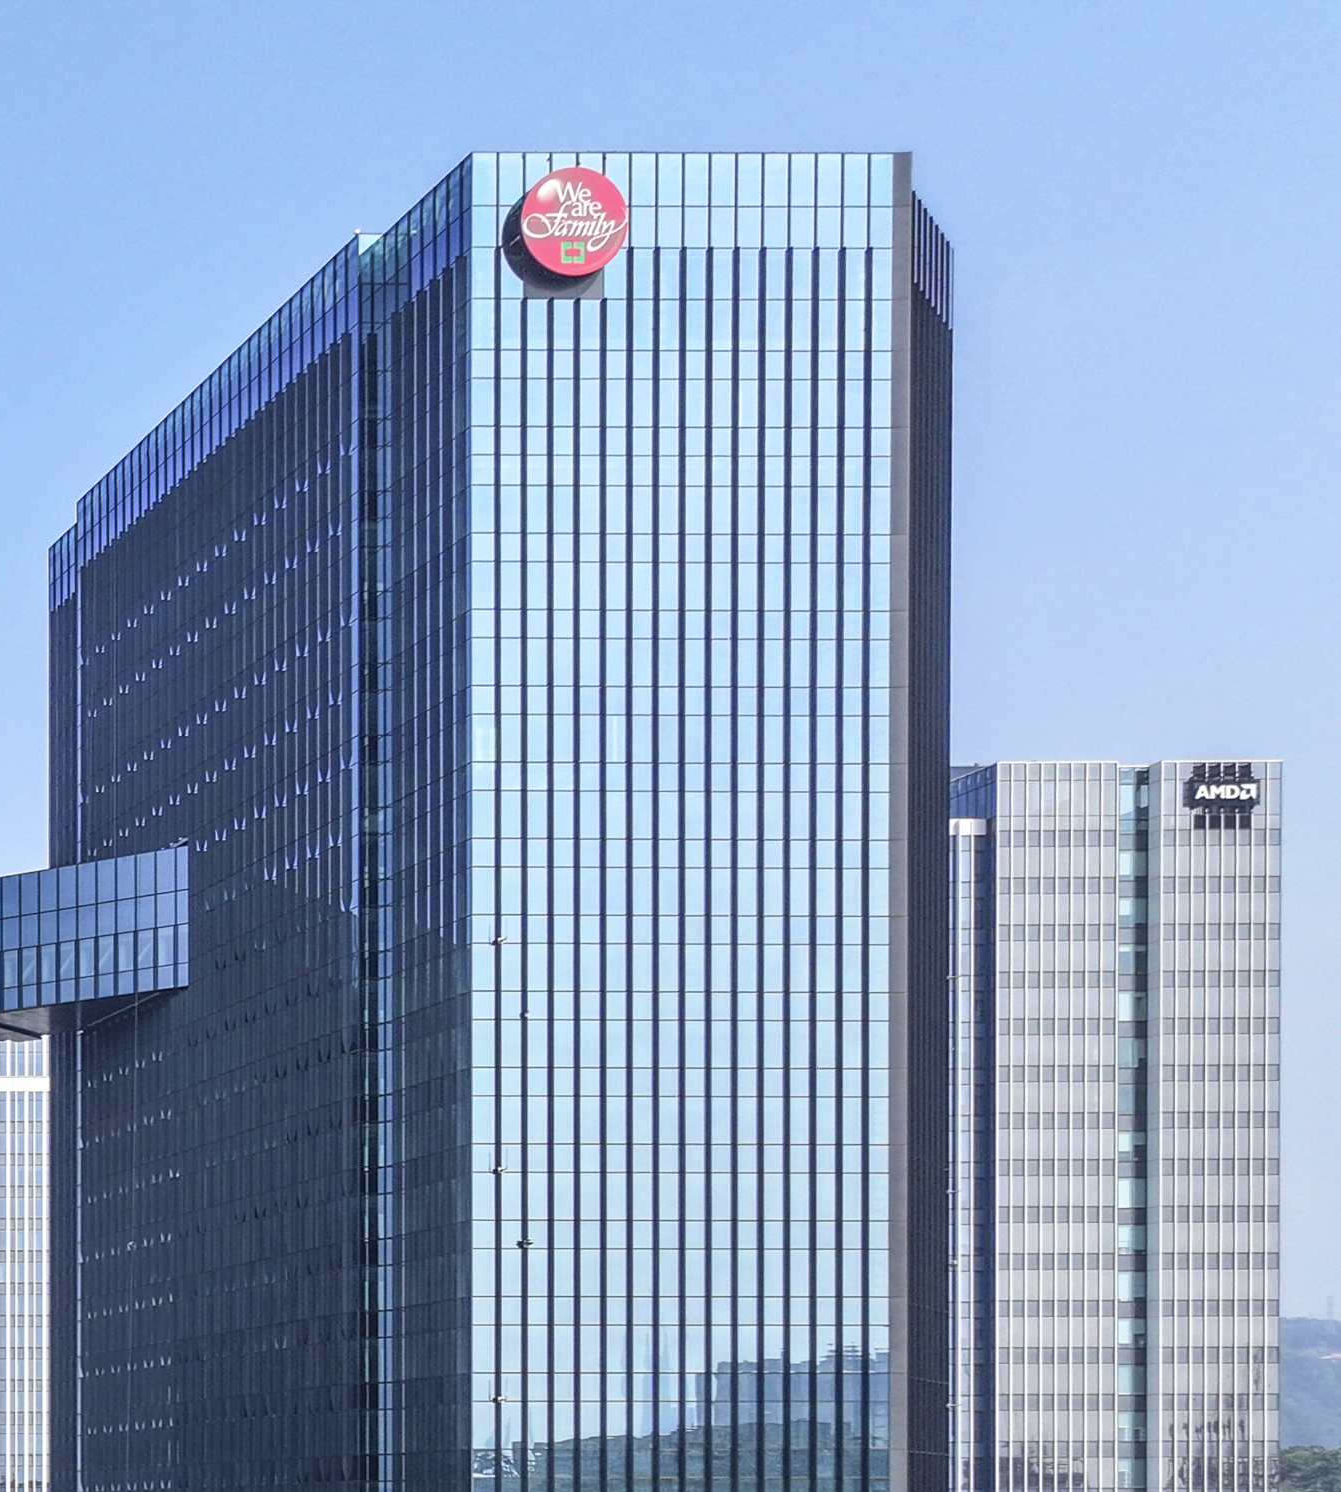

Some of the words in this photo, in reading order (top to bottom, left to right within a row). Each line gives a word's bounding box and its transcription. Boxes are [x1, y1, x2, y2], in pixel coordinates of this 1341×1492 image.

[555, 182, 591, 203] We
[570, 201, 602, 217] are
[523, 201, 627, 252] Family
[1195, 784, 1243, 800] AMD
